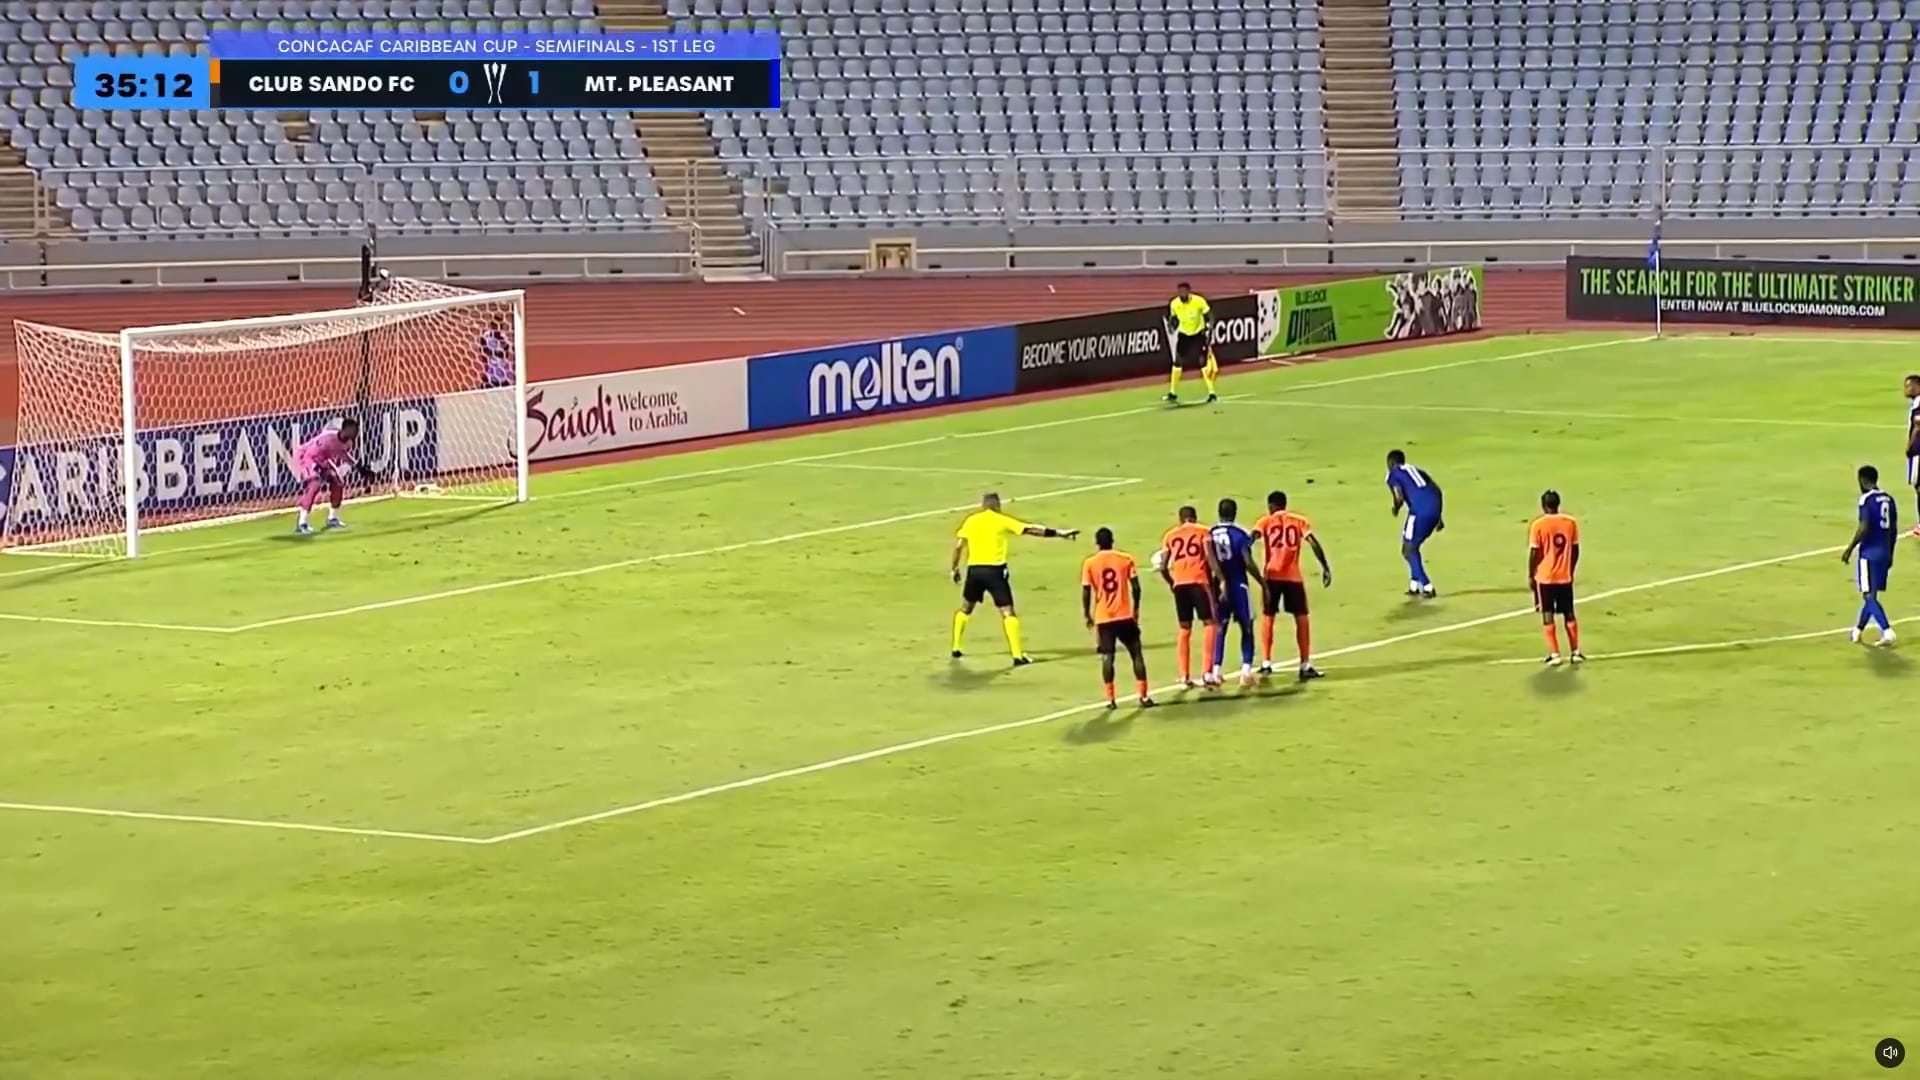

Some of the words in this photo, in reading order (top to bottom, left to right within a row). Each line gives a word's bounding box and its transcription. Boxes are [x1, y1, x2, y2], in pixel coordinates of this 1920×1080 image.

[1580, 268, 1612, 295] THE
[1616, 269, 1681, 297] SEARCH
[1686, 271, 1717, 298] FOR
[1722, 272, 1754, 298] THE
[1758, 272, 1839, 301] ULTIMATE
[1843, 275, 1915, 302] STRIKER
[1660, 299, 1696, 311] ENTER
[1697, 299, 1723, 312] NOW
[1724, 301, 1739, 312] AT
[1208, 316, 1255, 345] cron
[1022, 340, 1067, 369] BECOME
[1067, 336, 1097, 362] YOUR
[1098, 332, 1126, 358] OWN
[1127, 329, 1161, 355] HERO.
[809, 341, 961, 417] molten
[617, 391, 678, 412] Welcome
[508, 384, 617, 460] Saudi
[629, 414, 643, 432] to
[646, 406, 688, 430] Arabia
[0, 421, 301, 524] ARIBBEAN
[1880, 501, 1890, 529] 9
[1171, 534, 1201, 561] 26
[1270, 525, 1298, 548] 20
[1102, 567, 1119, 594] 8
